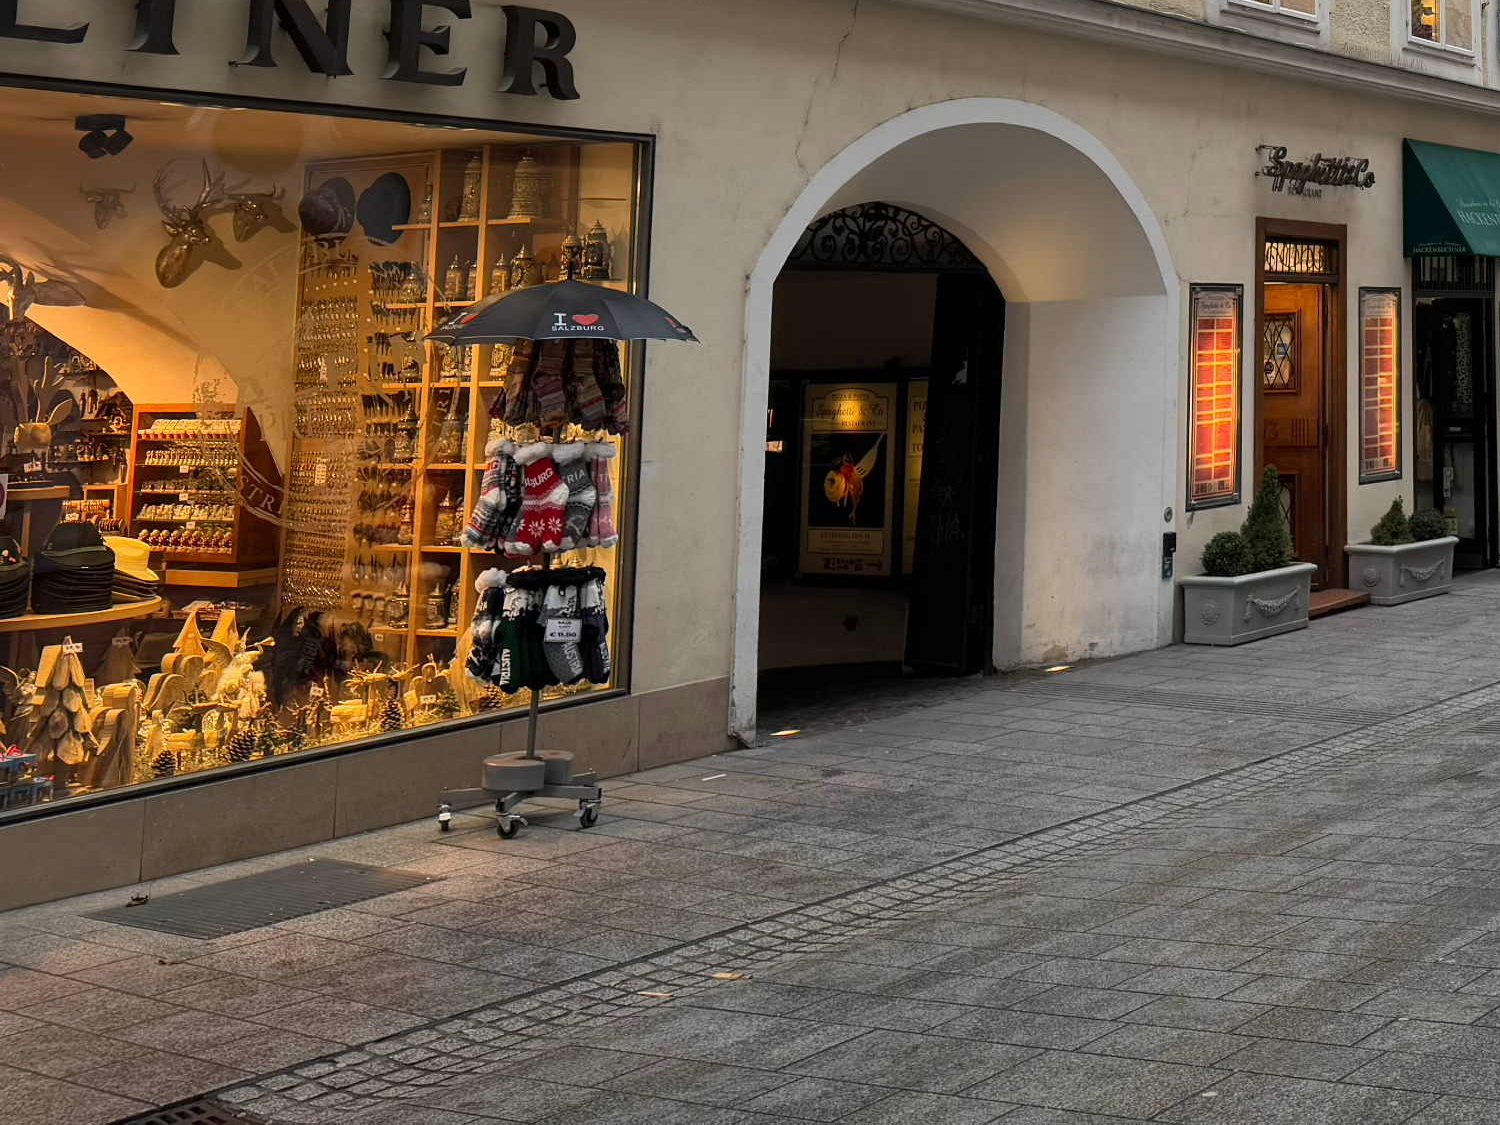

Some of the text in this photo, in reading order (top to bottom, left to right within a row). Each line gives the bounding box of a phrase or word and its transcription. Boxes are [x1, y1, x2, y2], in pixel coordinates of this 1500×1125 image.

[1412, 246, 1467, 254] HACKENBUCHNER
[553, 313, 567, 326] I
[815, 402, 884, 421] Spaghetti & Co
[500, 648, 511, 686] AUSTRIA
